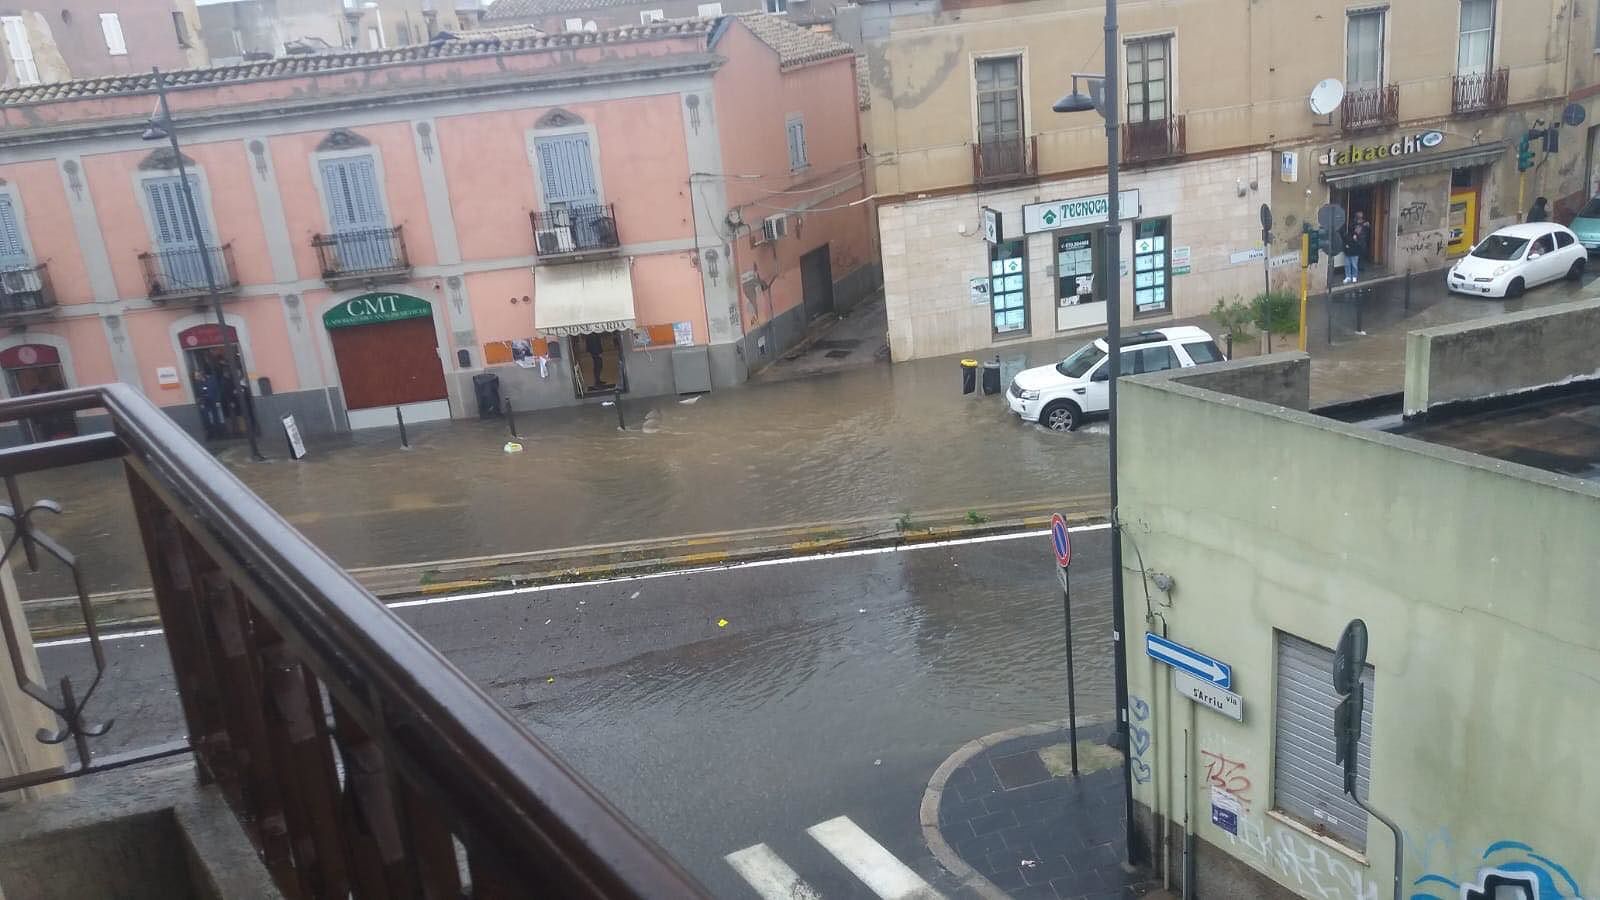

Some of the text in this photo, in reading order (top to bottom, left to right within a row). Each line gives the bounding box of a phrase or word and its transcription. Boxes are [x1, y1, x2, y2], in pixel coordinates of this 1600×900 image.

[1329, 134, 1421, 166] tabacchi
[1061, 198, 1108, 219] TECNOCA
[346, 295, 399, 317] CMT
[594, 320, 626, 331] SARDA
[1225, 695, 1237, 706] via
